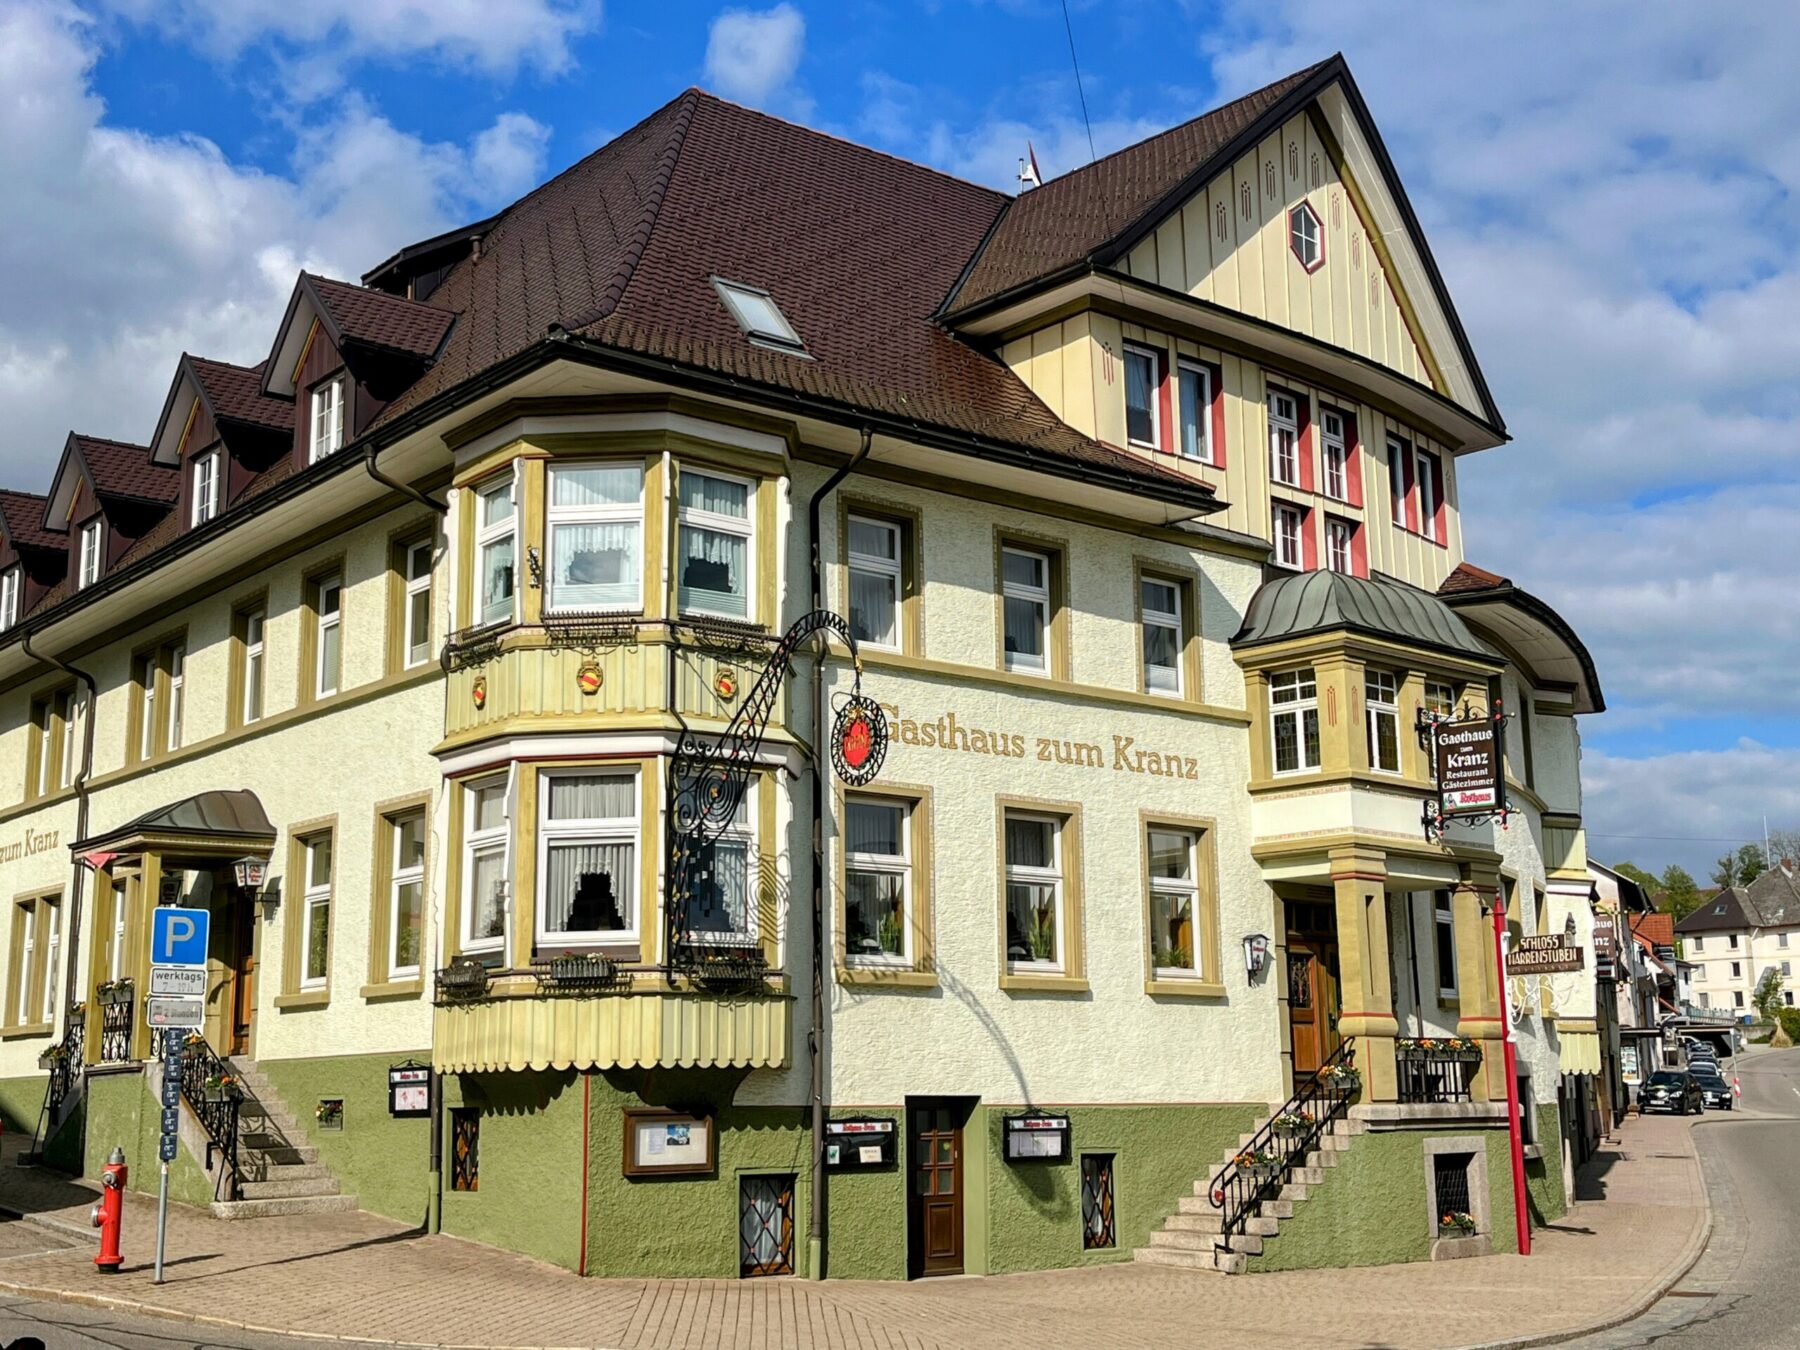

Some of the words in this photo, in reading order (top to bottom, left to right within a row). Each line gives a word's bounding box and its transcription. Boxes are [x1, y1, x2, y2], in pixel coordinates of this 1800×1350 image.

[1438, 729, 1494, 746] Gasthaus
[1037, 737, 1104, 768] zum
[1112, 735, 1199, 780] Kranz
[1447, 752, 1489, 769] Kranz
[1446, 767, 1489, 780] Restaurant
[1441, 778, 1494, 790] Gästezimmer
[24, 828, 59, 857] Kranz
[165, 915, 196, 958] P
[1519, 935, 1560, 950] SCHLOSS
[155, 971, 202, 983] werktags
